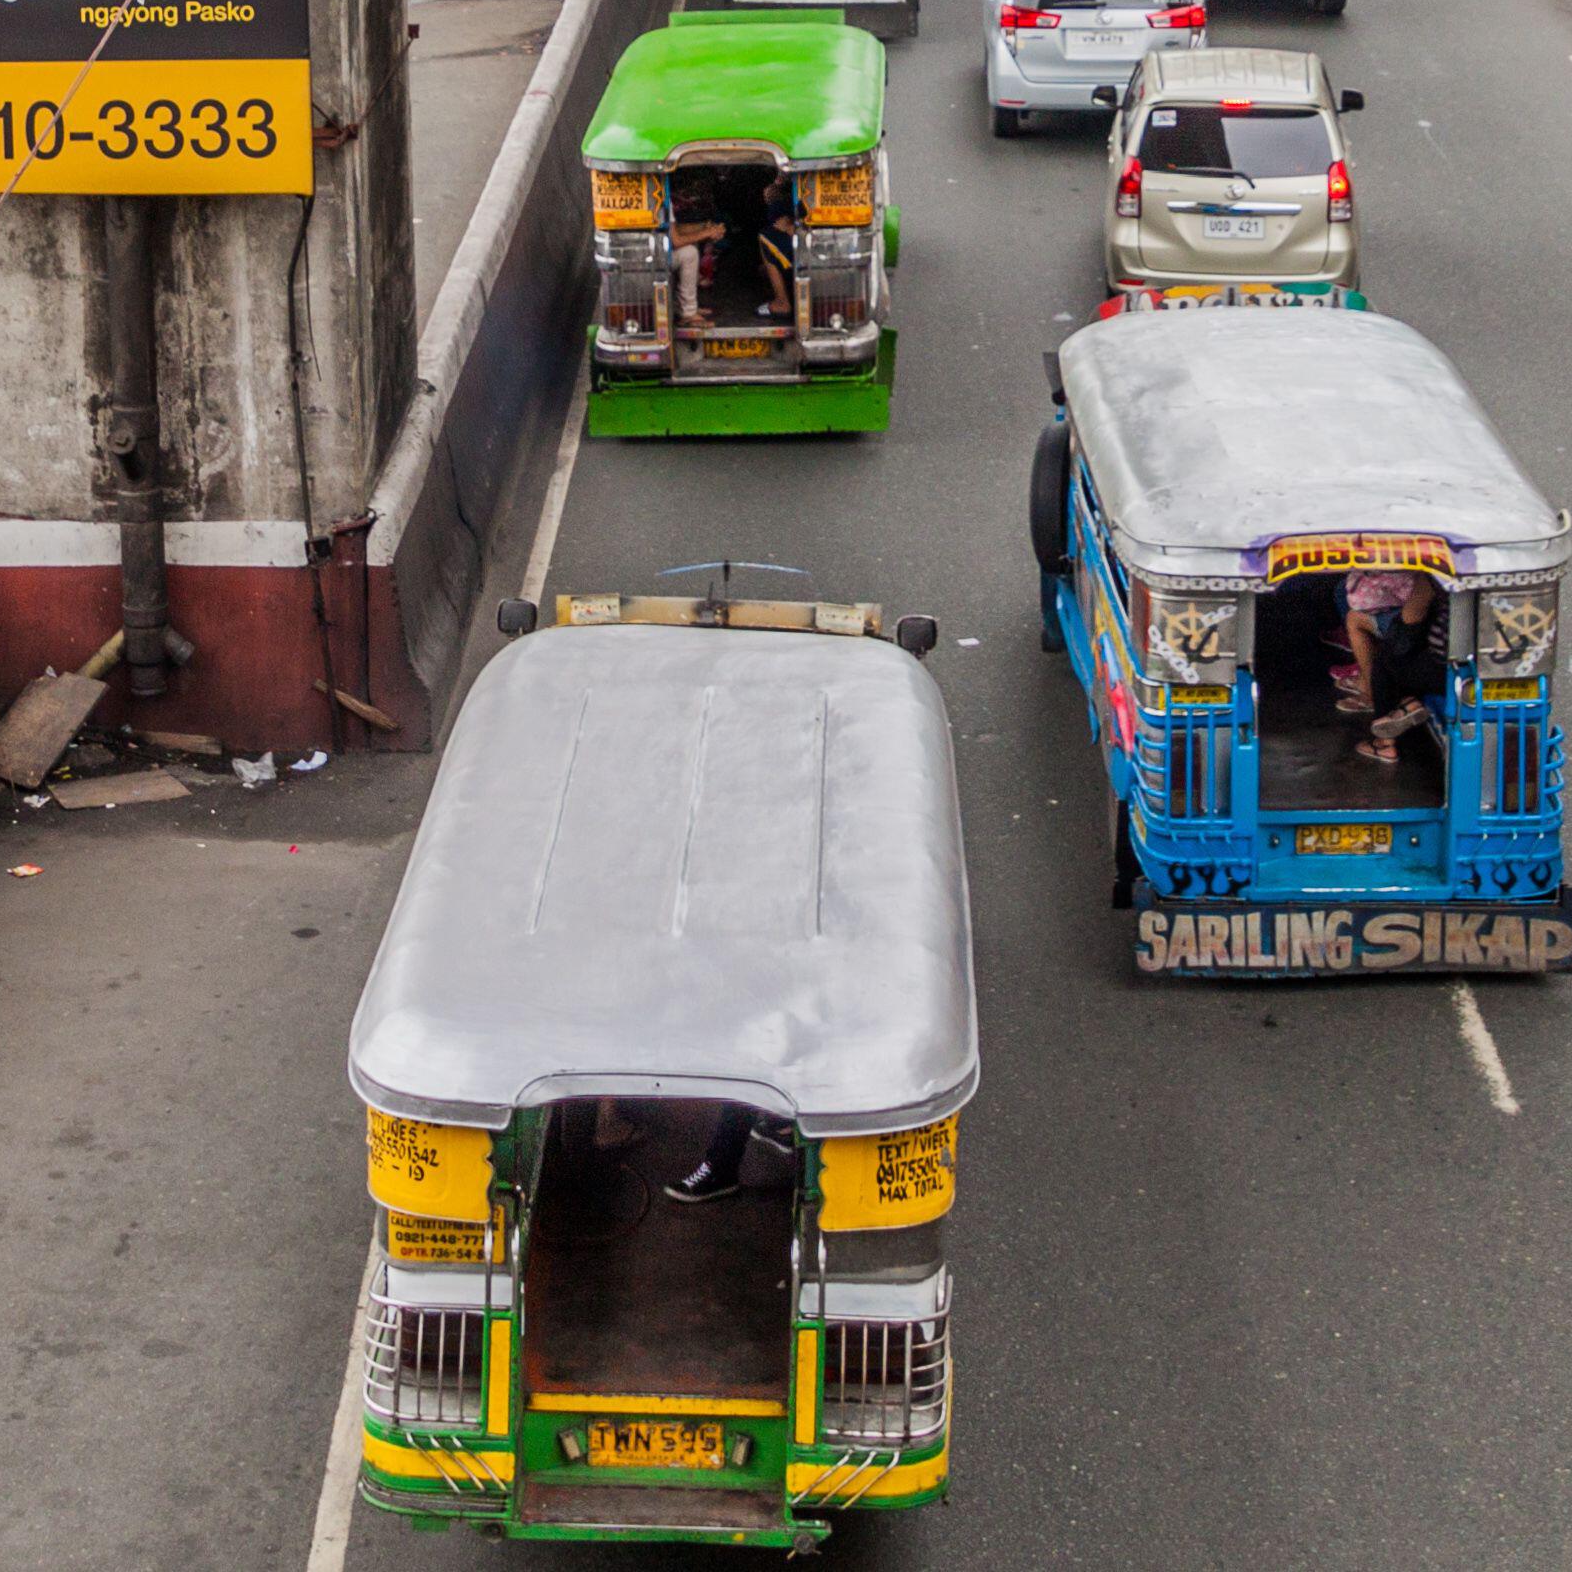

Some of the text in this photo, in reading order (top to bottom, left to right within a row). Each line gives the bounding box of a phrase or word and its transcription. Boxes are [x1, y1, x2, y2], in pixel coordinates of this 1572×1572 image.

[79, 1, 255, 28] ngayong Pasko
[1135, 909, 1352, 972] SARILING
[915, 1175, 944, 1198] TOTAL
[595, 1424, 719, 1453] TWN 595
